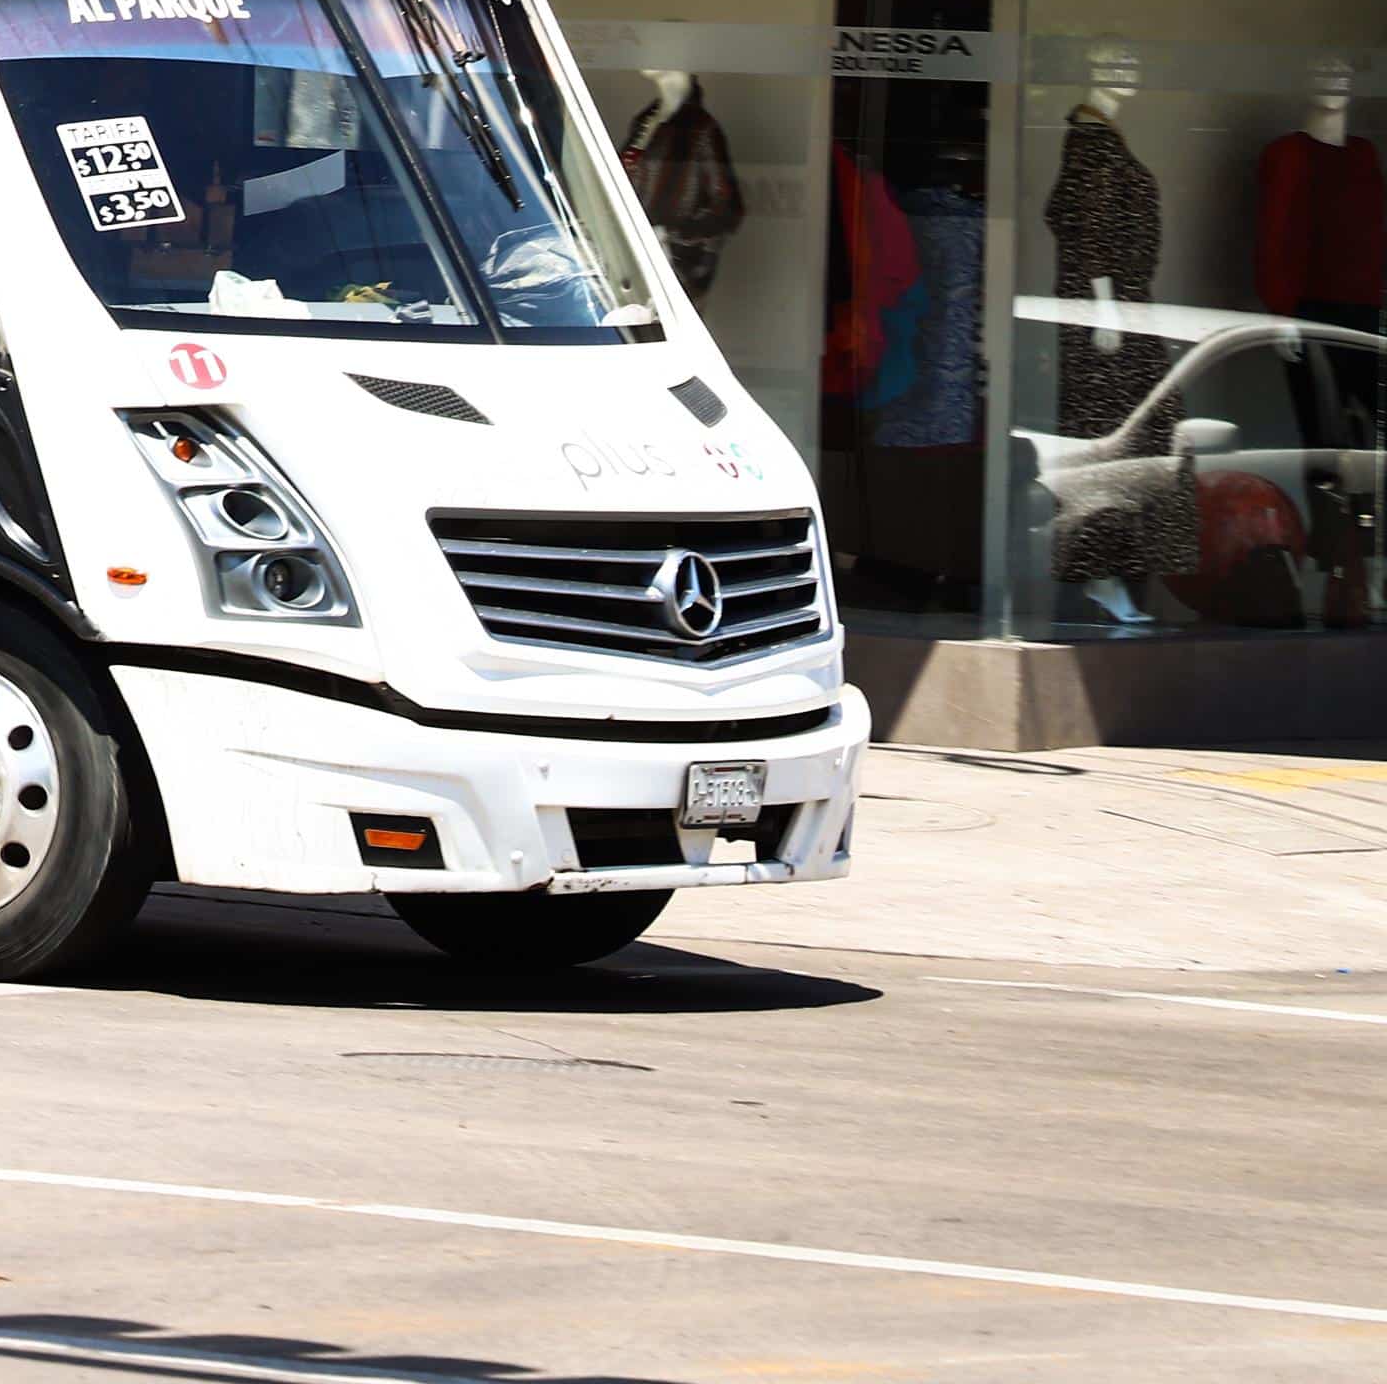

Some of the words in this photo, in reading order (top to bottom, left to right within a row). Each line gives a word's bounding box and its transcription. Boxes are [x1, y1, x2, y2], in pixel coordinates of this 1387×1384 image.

[832, 30, 974, 57] NESSA
[76, 141, 153, 177] $12.50
[99, 189, 171, 224] $3.50
[169, 348, 226, 384] 11
